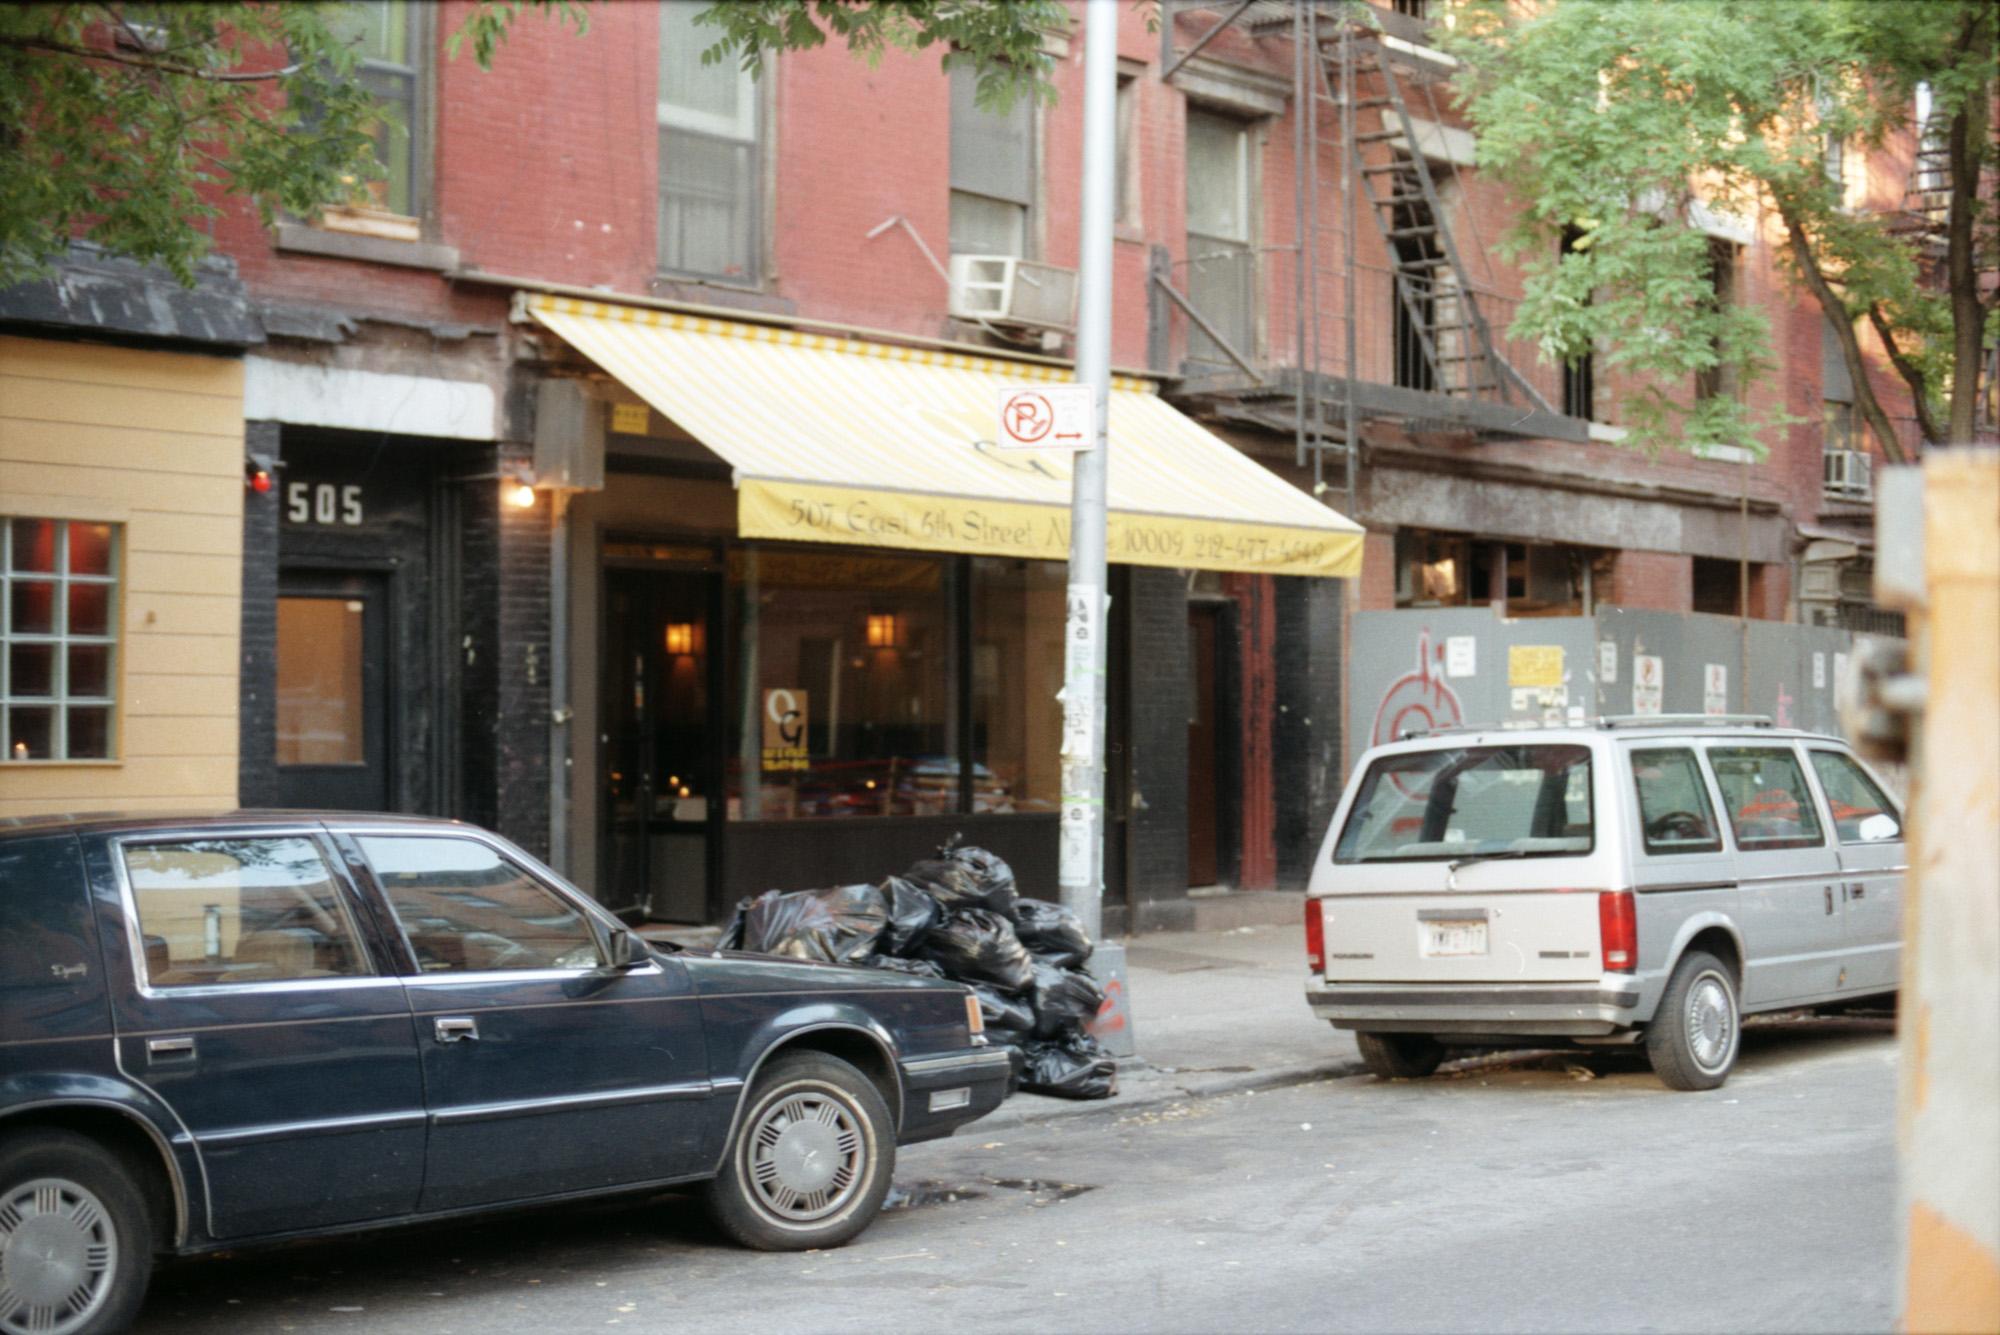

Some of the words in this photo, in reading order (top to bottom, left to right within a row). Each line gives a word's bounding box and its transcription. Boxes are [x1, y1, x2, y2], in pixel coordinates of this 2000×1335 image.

[288, 482, 363, 526] 505
[789, 500, 836, 529] 507
[847, 500, 909, 535] East
[921, 509, 955, 538] 6th
[963, 511, 1032, 544] Street
[1125, 527, 1184, 557] 10009
